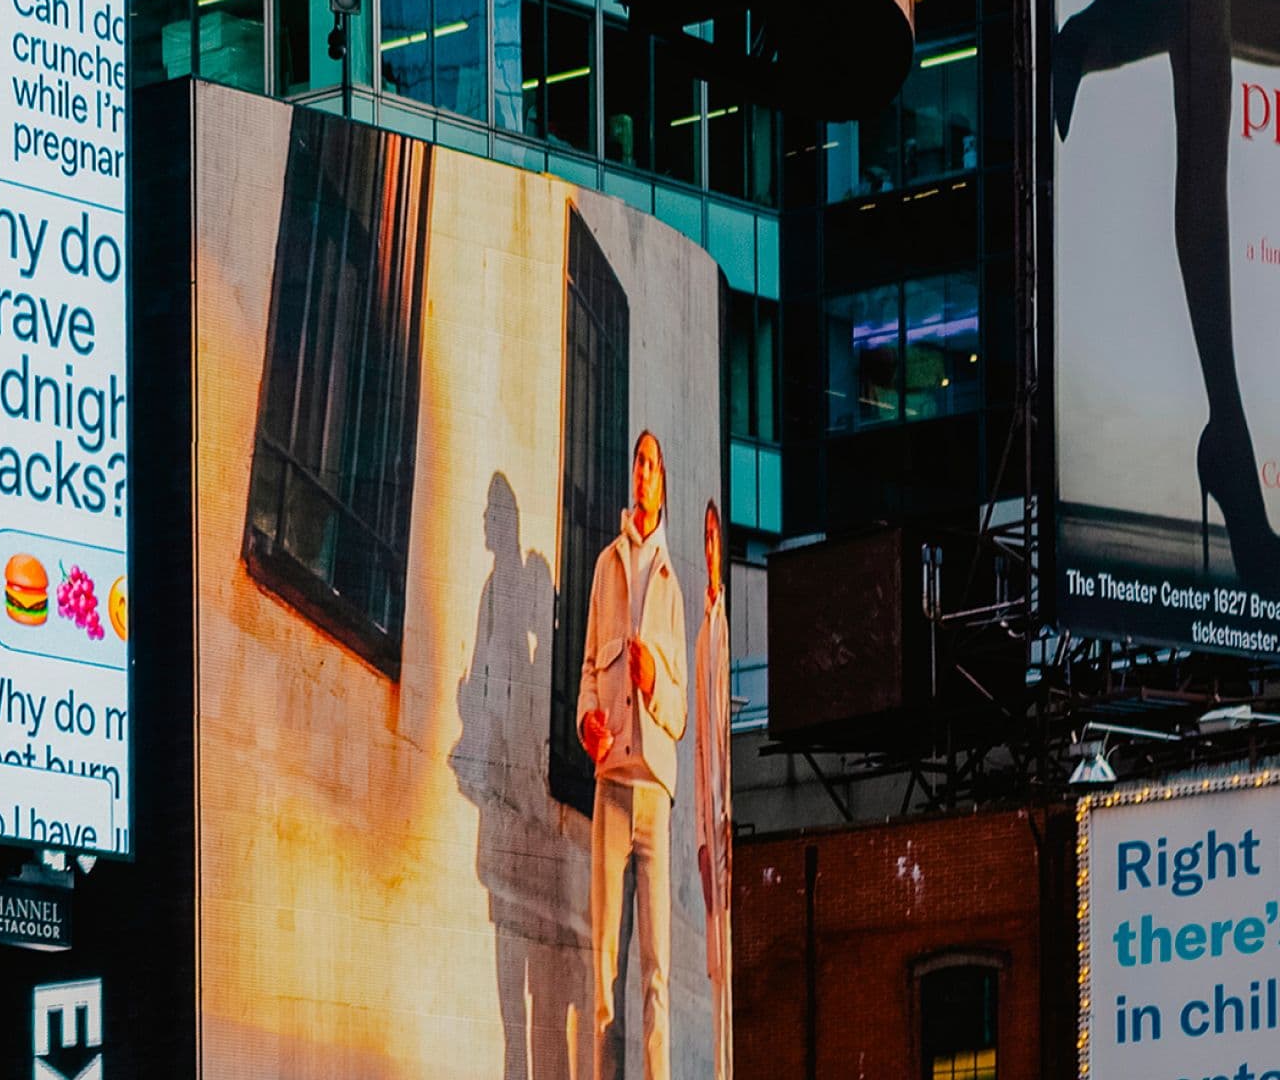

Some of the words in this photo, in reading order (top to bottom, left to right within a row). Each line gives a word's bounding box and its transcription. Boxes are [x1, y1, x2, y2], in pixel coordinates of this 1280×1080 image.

[12, 73, 88, 124] while
[60, 211, 123, 286] do
[1066, 568, 1095, 597] The
[1098, 571, 1158, 605] Theater
[1160, 580, 1211, 612] Center
[1213, 587, 1248, 616] 1627
[54, 688, 96, 736] do
[1117, 828, 1261, 898] Right
[1113, 900, 1280, 968] there’
[1116, 994, 1162, 1045] in
[1179, 977, 1278, 1038] chil
